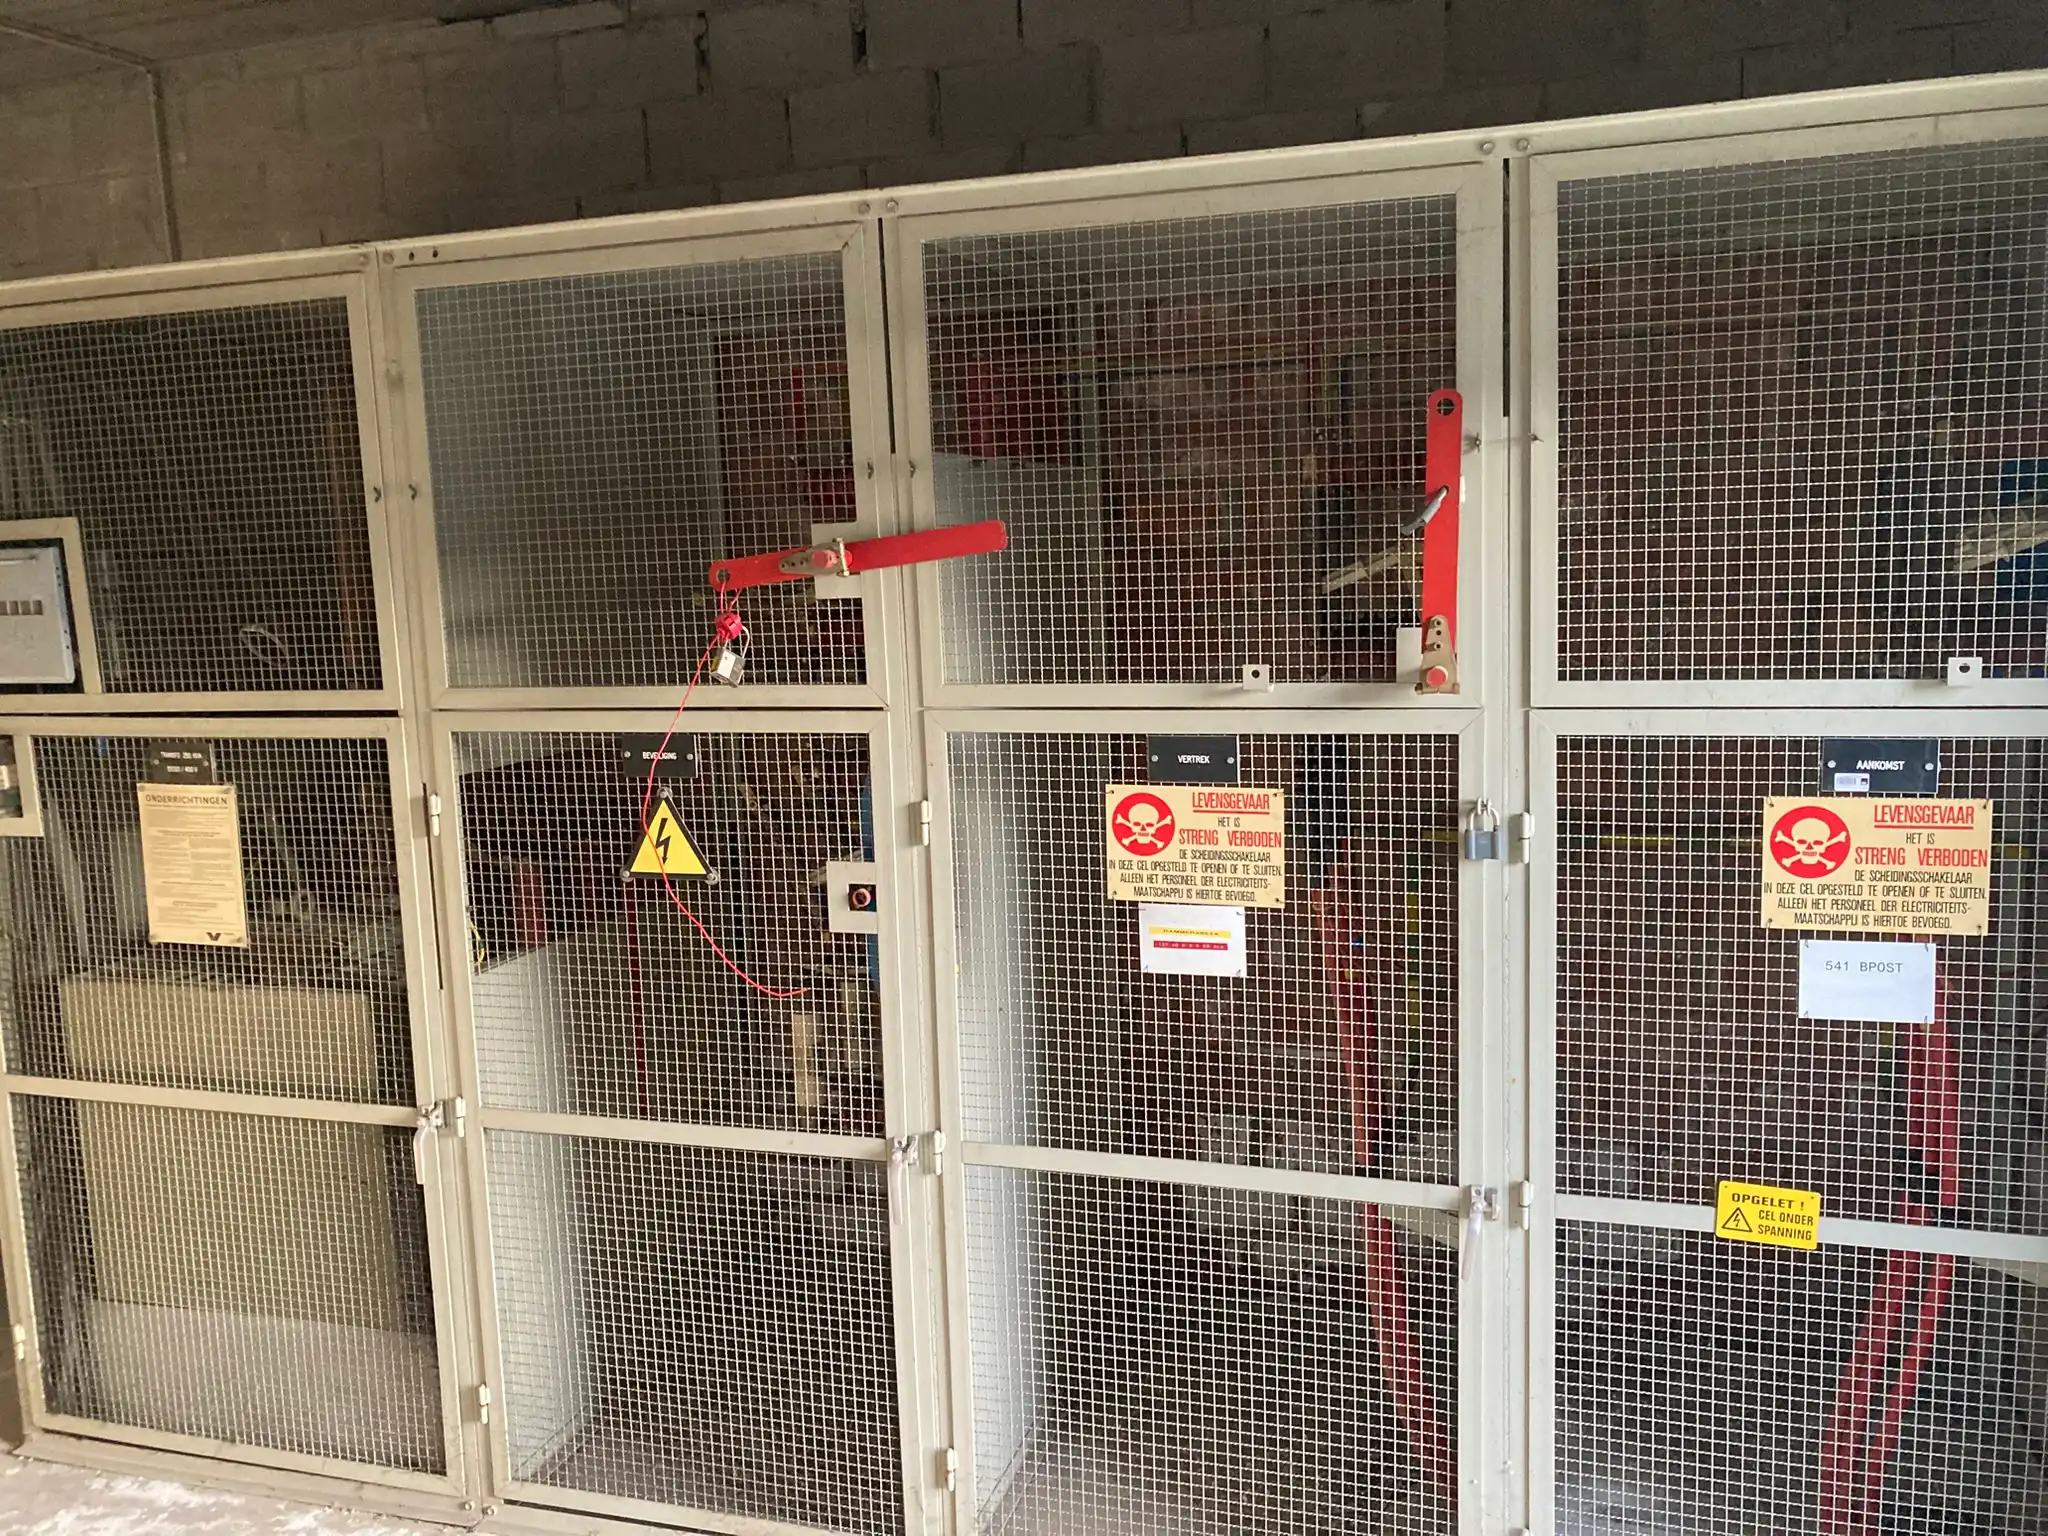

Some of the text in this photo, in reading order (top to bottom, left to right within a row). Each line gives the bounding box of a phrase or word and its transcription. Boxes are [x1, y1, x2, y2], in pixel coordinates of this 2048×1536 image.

[1177, 754, 1211, 764] VERTREK
[1856, 759, 1905, 771] AANKOMST
[145, 794, 228, 805] ONDERRICHTINGEN
[1192, 791, 1270, 810] LEVENSGEVAAR
[1873, 804, 1975, 824] LEVENSGEVAAR
[1217, 817, 1241, 828] HET IS
[1178, 828, 1282, 848] STRENG VERBODEN
[1905, 832, 1935, 845] HET IS
[1179, 848, 1271, 862] DE SCHEIDINGSSCHAKELAAR
[1854, 846, 1988, 868] STRENG VERBODEN
[1109, 859, 1116, 869] IN
[1119, 859, 1133, 870] DEZE
[1137, 860, 1148, 871] CEL
[1150, 860, 1187, 872] OPGESTELD
[1190, 862, 1198, 873] TE
[1201, 862, 1227, 874] OPENEN
[1229, 863, 1238, 875] OF
[1242, 864, 1250, 875] TE
[1120, 872, 1271, 889] ALLEEN HET PERSONEEL DER ELECTRICITEITS-
[1854, 870, 1973, 884] DE SCHEIDINGSSCHAKELAAR
[1186, 888, 1193, 899] IS
[1195, 888, 1222, 900] HIERTOE
[1763, 882, 1987, 900] IN DEZE CEL OPGESTELD TE OPENEN OF TE SLUITEN.
[1777, 897, 1971, 915] ALLEEN HET PERSONEEL DER ELECTRICITEITS-
[1861, 914, 1870, 927] IS
[1873, 914, 1908, 928] HIERTOE
[1911, 916, 1952, 929] BEVOEGD.
[1825, 960, 1904, 973] 541 BPOST
[1731, 1192, 1805, 1211] OPGELET !
[1758, 1208, 1814, 1227] CEL ONDER
[1757, 1223, 1812, 1241] SPANNING
